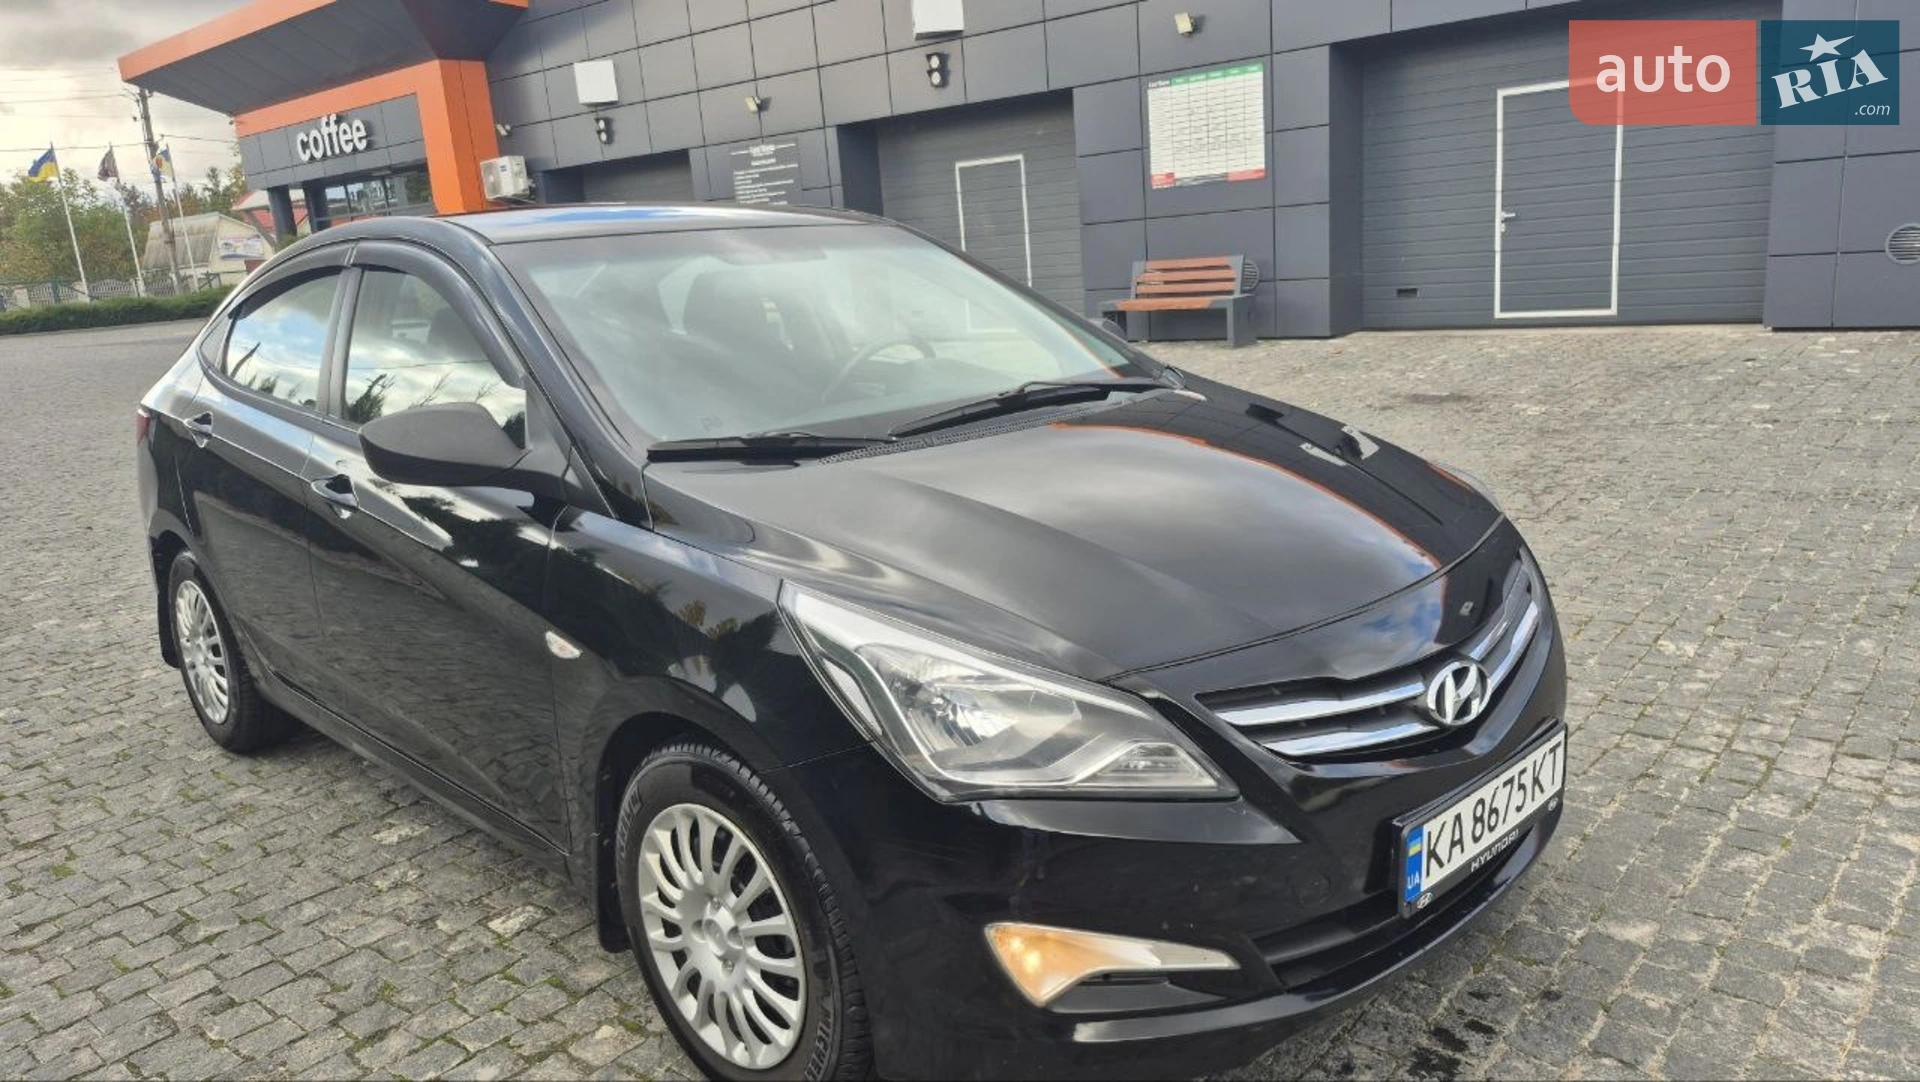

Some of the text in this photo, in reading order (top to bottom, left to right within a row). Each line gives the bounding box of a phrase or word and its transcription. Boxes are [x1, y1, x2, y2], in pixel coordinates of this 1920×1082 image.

[296, 113, 367, 162] coffee
[1471, 829, 1519, 872] HYUNDAI
[1407, 872, 1420, 889] UA
